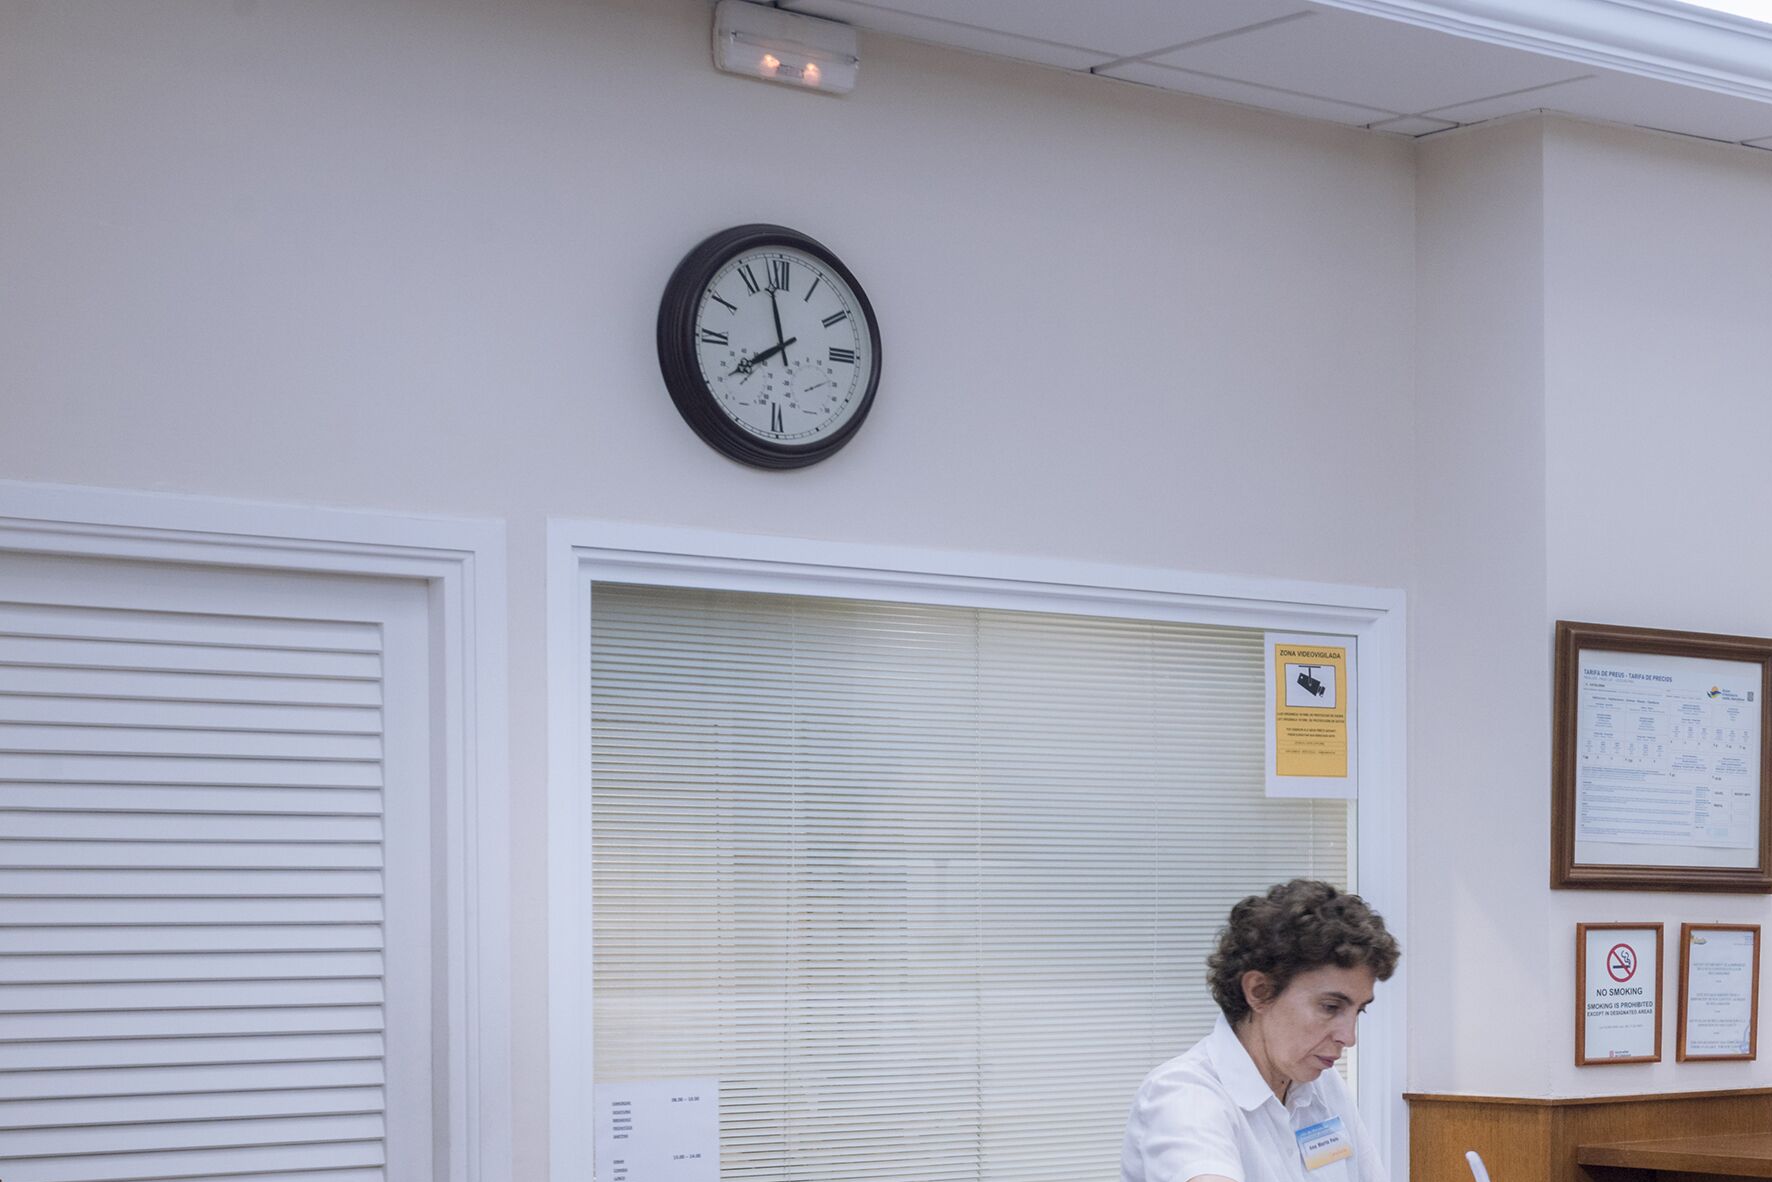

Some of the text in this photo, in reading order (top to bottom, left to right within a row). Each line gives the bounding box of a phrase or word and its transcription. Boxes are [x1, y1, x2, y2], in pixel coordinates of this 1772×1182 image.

[738, 264, 760, 296] XI
[771, 260, 789, 291] XII
[711, 291, 737, 316] X
[821, 311, 847, 328] II
[702, 328, 729, 345] IX
[829, 347, 854, 364] III
[1297, 650, 1341, 659] VIDEOVIGILADA
[1596, 987, 1643, 997] NO SMOKING
[1587, 1002, 1613, 1010] SMOKING
